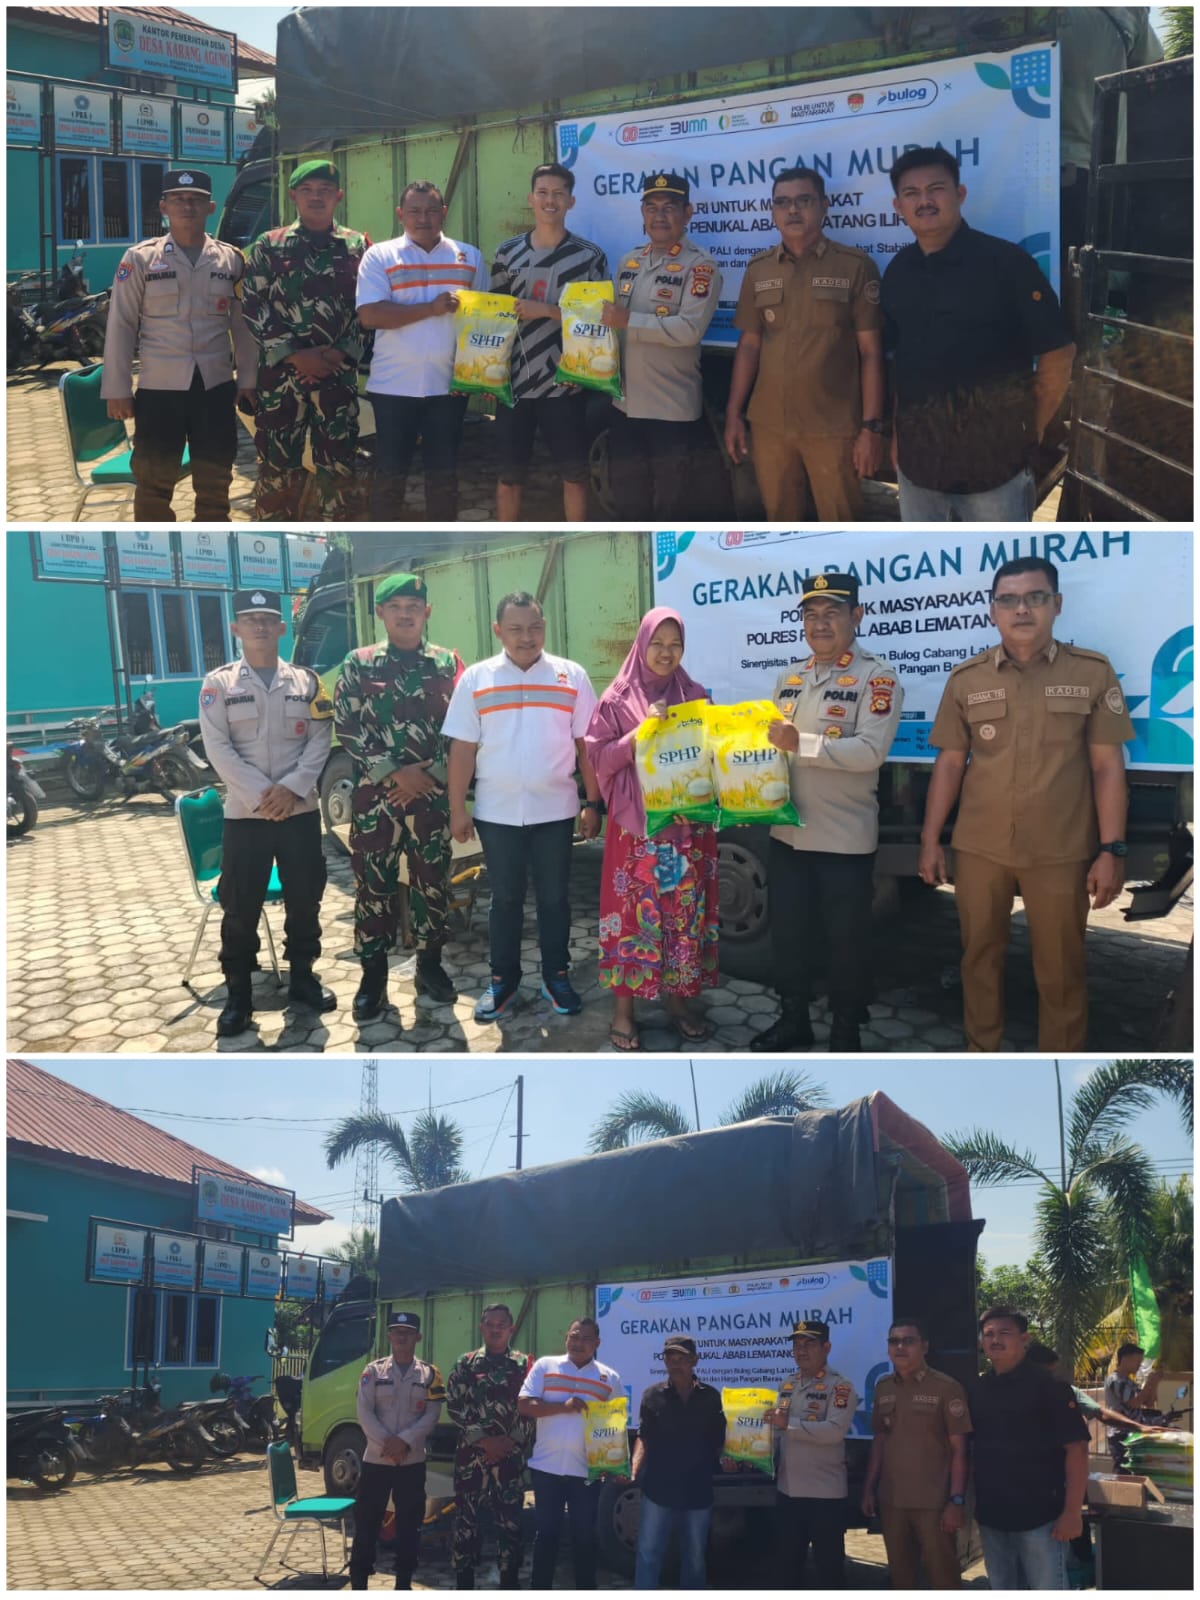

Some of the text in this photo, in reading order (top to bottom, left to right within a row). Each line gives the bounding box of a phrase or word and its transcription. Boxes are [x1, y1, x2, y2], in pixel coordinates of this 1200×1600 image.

[139, 36, 163, 54] DESA
[887, 88, 927, 102] bulog
[711, 199, 757, 213] UNTUK
[690, 219, 748, 233] PENUKAL
[822, 213, 876, 230] ATANG
[710, 246, 732, 255] PALI
[655, 275, 683, 285] POLRI
[470, 333, 505, 347] SPHP
[692, 568, 808, 607] GERAKAN
[880, 589, 995, 614] MASYARAKAT
[747, 629, 797, 645] POLRES
[868, 619, 912, 637] ABAB
[915, 614, 996, 633] LEMATAN
[741, 658, 789, 671] Sinergisitas
[889, 651, 920, 662] Bulog
[924, 647, 965, 661] Cabang
[899, 663, 941, 675] Pangan
[824, 690, 859, 702] POLRI
[659, 745, 702, 764] SPHP
[732, 748, 777, 764] SPHP
[801, 1276, 824, 1285] bulog
[620, 1307, 853, 1335] GERAKAN PANGAN MURAH
[698, 1337, 789, 1348] UNTUK MASYARAKAT
[723, 1351, 747, 1360] ABAB
[751, 1367, 775, 1376] Cabang
[776, 1367, 796, 1375] Lahat
[739, 1375, 761, 1384] Pangan
[762, 1375, 782, 1383] Beras
[592, 1427, 617, 1438] SPHP
